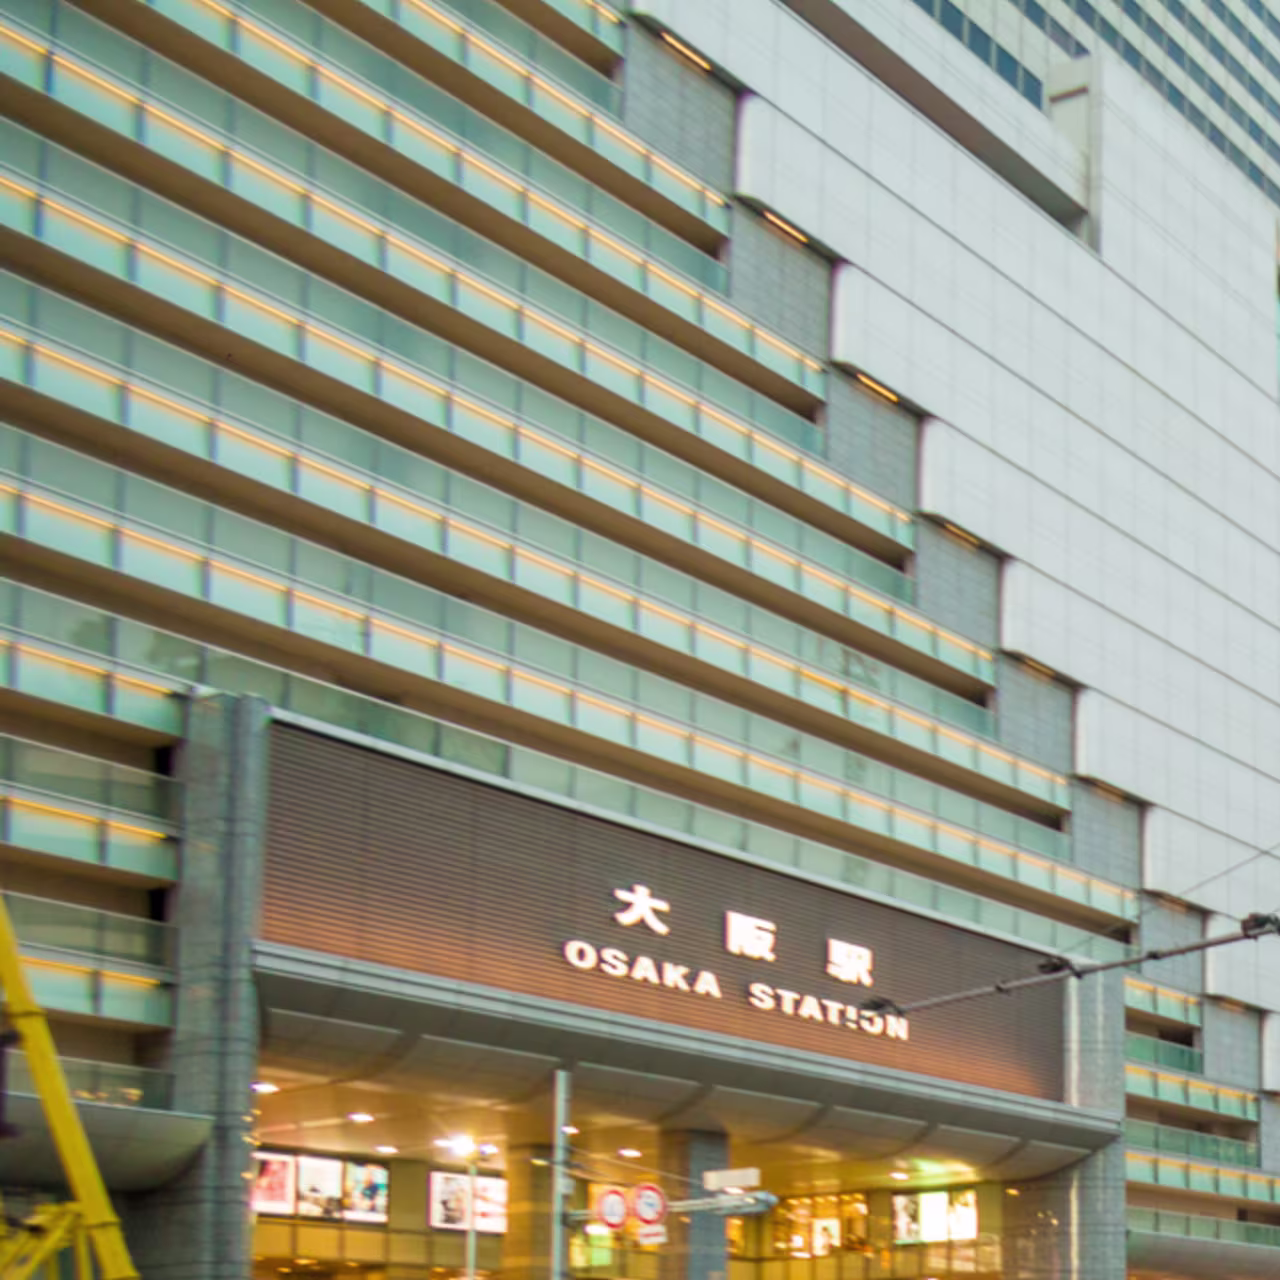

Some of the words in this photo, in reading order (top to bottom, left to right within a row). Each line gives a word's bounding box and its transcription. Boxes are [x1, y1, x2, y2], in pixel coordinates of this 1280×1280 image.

[563, 939, 722, 999] OSAKA
[612, 883, 874, 988] 大阪駅
